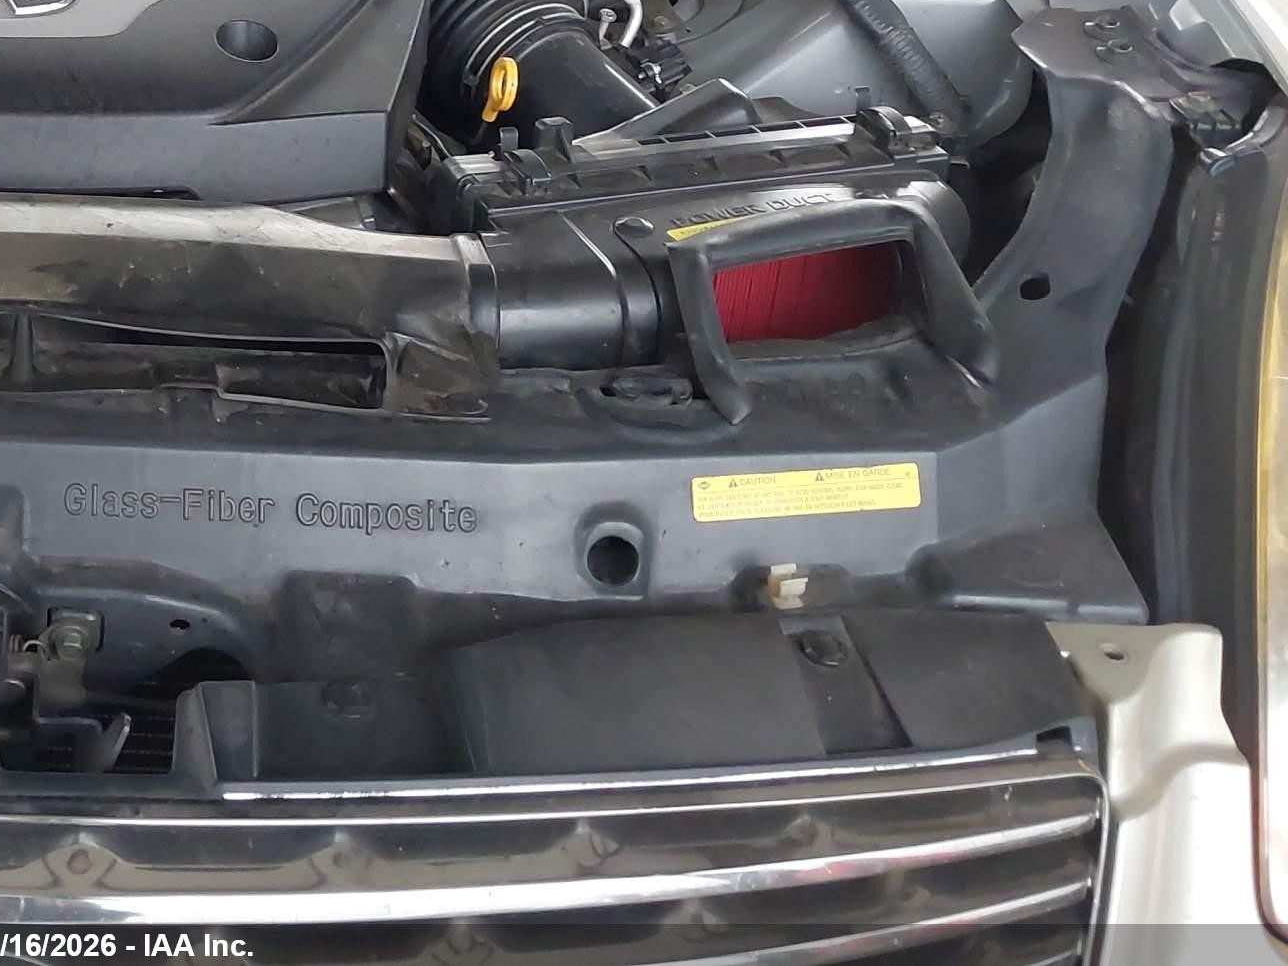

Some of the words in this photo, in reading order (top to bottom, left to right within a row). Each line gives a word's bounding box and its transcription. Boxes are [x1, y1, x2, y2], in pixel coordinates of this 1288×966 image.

[669, 203, 766, 227] POWER
[766, 192, 838, 211] DUCT
[739, 476, 777, 486] CAUTION
[63, 482, 276, 524] Glass-Fiber
[296, 491, 478, 536] Composite
